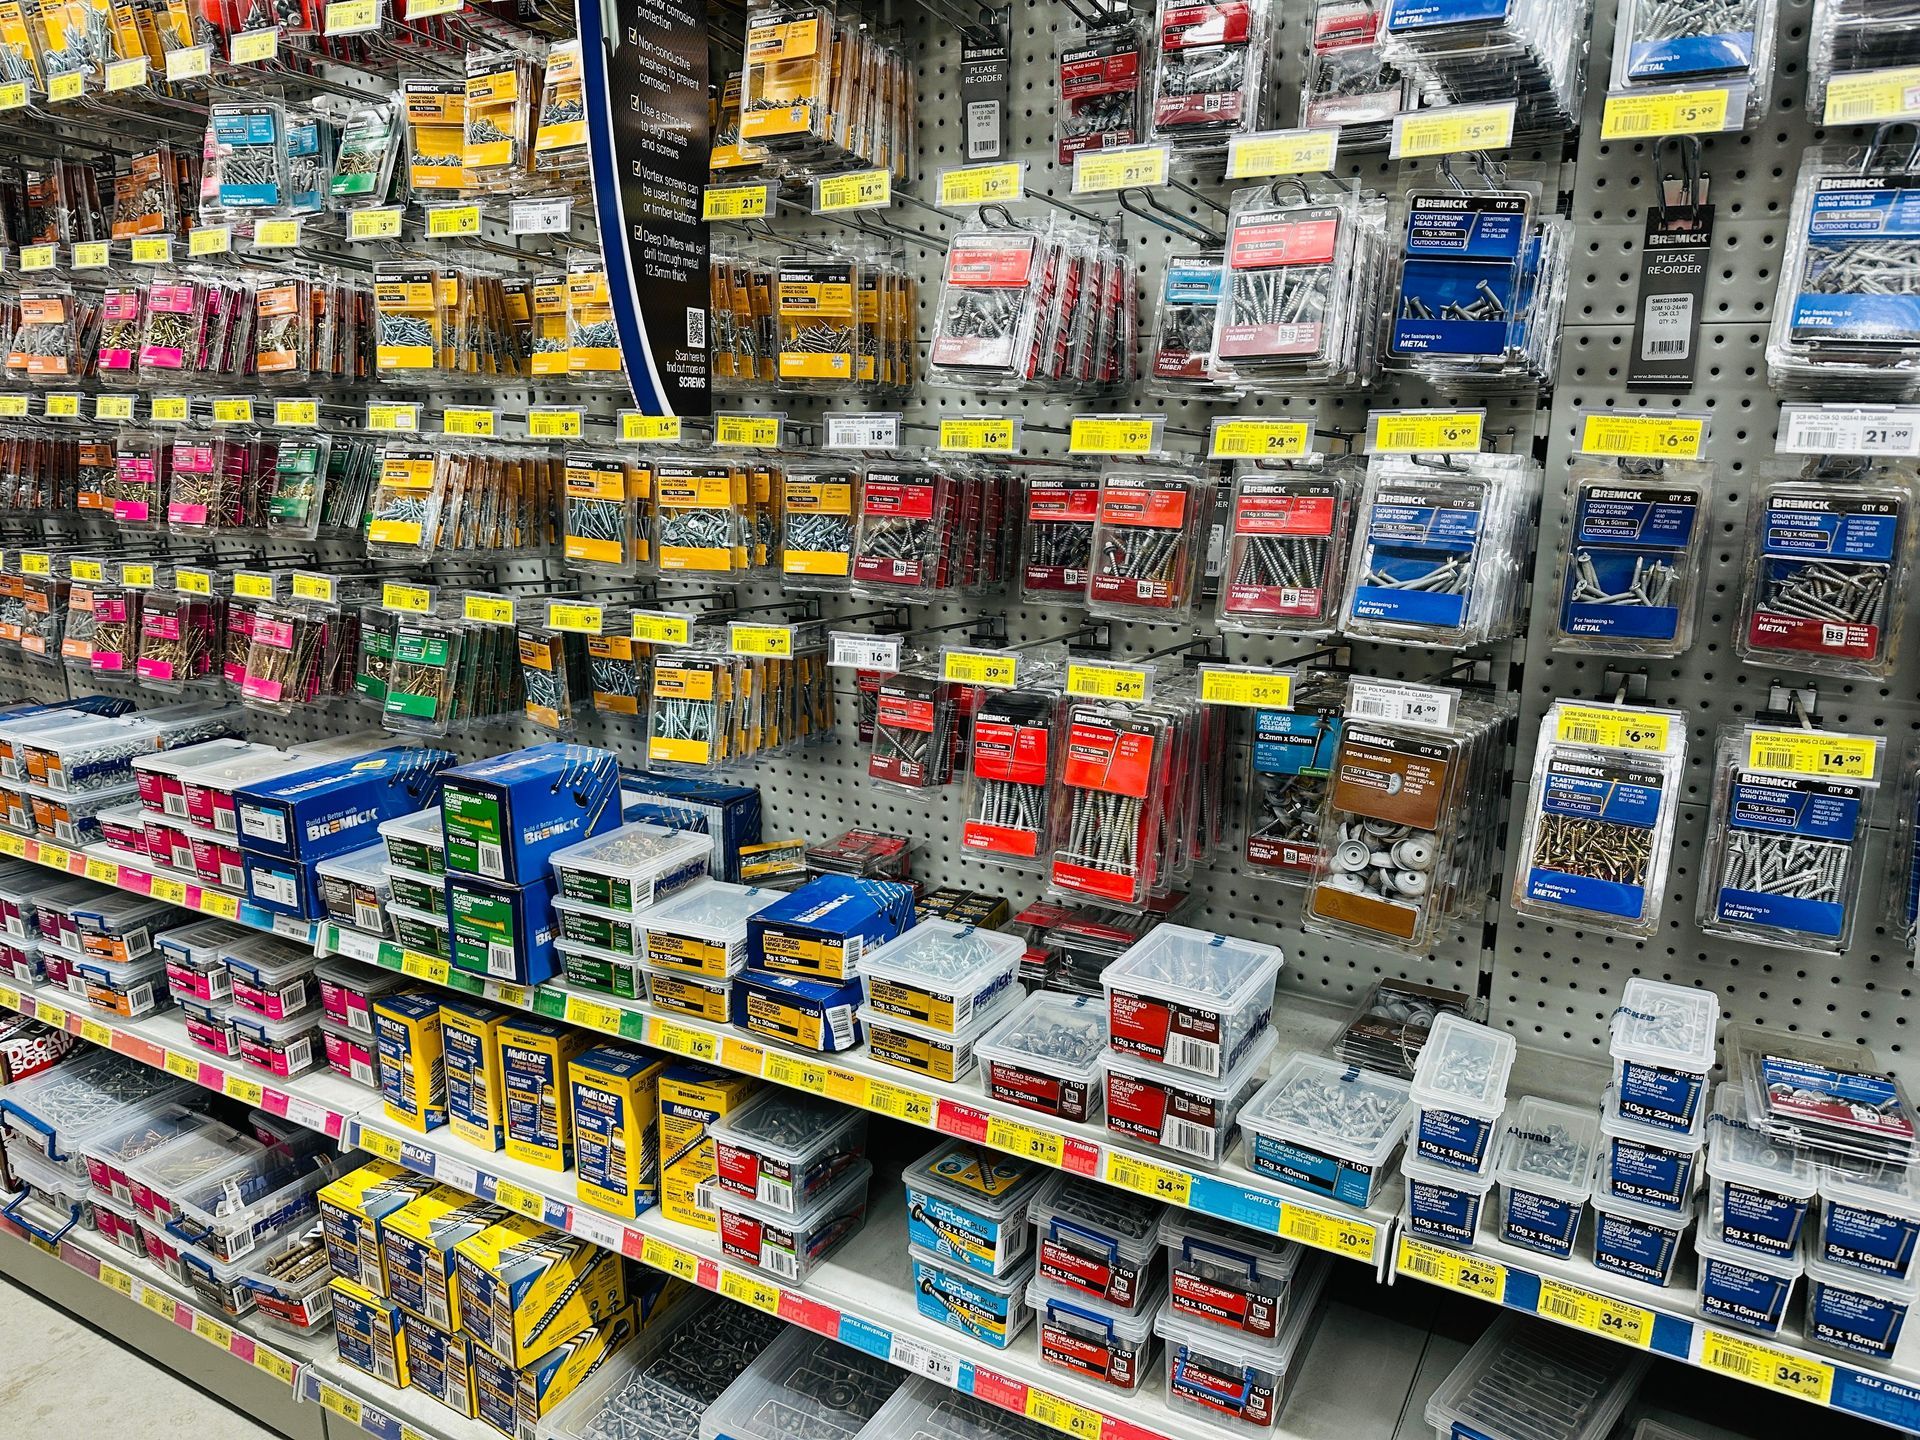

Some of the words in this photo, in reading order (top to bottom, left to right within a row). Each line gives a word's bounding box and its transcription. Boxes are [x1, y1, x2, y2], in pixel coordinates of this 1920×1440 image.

[638, 6, 672, 31] protection
[667, 5, 695, 28] corrosion
[1394, 13, 1423, 25] METAL
[639, 35, 691, 70] Non-conductive
[964, 48, 1004, 58] BREMICK
[639, 55, 667, 76] washers
[669, 67, 675, 79] to
[970, 65, 997, 74] PLEASE
[640, 73, 671, 94] corrosion
[965, 73, 1002, 84] RE-ORDER
[1159, 101, 1185, 112] TIMBER
[1680, 106, 1714, 121] $5.99
[641, 119, 648, 131] to
[642, 138, 654, 151] and
[656, 143, 679, 159] screws
[642, 166, 663, 184] Vortex
[665, 176, 686, 191] screws
[688, 186, 698, 195] can
[1820, 179, 1885, 190] BREMICK
[643, 183, 652, 195] be
[653, 188, 669, 201] used
[671, 191, 679, 204] for
[681, 197, 697, 210] metal
[1416, 198, 1468, 209] BREMICK
[644, 203, 650, 212] or
[652, 204, 672, 218] timber
[1415, 214, 1464, 222] COUNTERSUNK
[644, 230, 661, 246] Deep
[1650, 234, 1708, 244] BREMICK
[683, 258, 699, 269] metal
[1656, 254, 1695, 263] PLEASE
[672, 269, 687, 282] thick
[1647, 265, 1701, 274] RE-ORDER
[1798, 316, 1833, 325] METAL
[1400, 340, 1428, 348] METAL
[675, 350, 688, 361] Scan
[667, 361, 676, 372] find
[699, 366, 705, 374] on
[679, 376, 705, 388] SCREWS
[1444, 427, 1471, 441] $6.99
[1242, 484, 1285, 494] BREMICK
[1591, 488, 1642, 499] BREMICK
[1377, 493, 1426, 505] BREMICK
[1453, 499, 1464, 507] QTY
[1772, 498, 1830, 510] BREMICK
[1862, 504, 1876, 512] QTY
[1879, 504, 1888, 512] 50
[1772, 514, 1822, 522] COUNTERSUNK
[858, 562, 878, 570] TIMBER
[1095, 582, 1119, 590] TIMBER
[1231, 591, 1260, 600] TIMBER
[1357, 606, 1384, 616] METAL
[1573, 624, 1600, 632] METAL
[1758, 624, 1788, 634] METAL
[1826, 630, 1844, 640] B8
[1406, 703, 1436, 716] 14.99
[1348, 731, 1394, 748] BREMICK
[1420, 746, 1432, 754] QTY
[1626, 729, 1655, 743] $6.99
[1823, 753, 1861, 767] 14.99
[1552, 762, 1604, 777] BREMICK
[1644, 775, 1656, 783] 100
[1551, 776, 1603, 788] PLASTERBOARD
[1742, 774, 1798, 788] BREMICK
[1828, 786, 1842, 794] QTY
[445, 792, 482, 805] PLASTERBOARD
[484, 793, 498, 801] 1000
[1740, 788, 1790, 798] COUNTERSUNK
[1759, 795, 1786, 803] DRILLER
[306, 819, 321, 827] Build
[327, 812, 344, 823] Better
[345, 807, 357, 816] with
[307, 807, 379, 842] BREMICK
[524, 817, 580, 845] BREMICK
[453, 893, 494, 907] PLASTERBOARD
[496, 895, 510, 904] 1000
[1533, 888, 1562, 899] METAL
[1724, 909, 1755, 919] METAL
[828, 939, 841, 947] 250
[873, 1000, 885, 1009] 10g
[891, 1004, 911, 1016] 30mm
[1200, 1010, 1217, 1021] 100
[507, 1048, 527, 1061] Multi
[528, 1054, 547, 1065] ONE
[1629, 1066, 1657, 1078] WAFER
[1659, 1074, 1678, 1083] HEAD
[578, 1086, 598, 1099] Multi
[598, 1092, 618, 1106] ONE
[906, 1101, 929, 1114] 24.95
[954, 1107, 968, 1115] TYPE
[1624, 1102, 1643, 1115] 10g
[1653, 1109, 1689, 1126] 22mm
[1420, 1141, 1438, 1154] 10g
[1448, 1148, 1478, 1165] 16mm
[1258, 1158, 1277, 1173] 12g
[1285, 1167, 1311, 1182] 40mm
[1350, 1162, 1369, 1174] 100
[1157, 1178, 1186, 1193] 34.99
[1615, 1181, 1636, 1194] 10g
[1645, 1188, 1680, 1203] 22mm
[1243, 1193, 1274, 1206] VORTEX
[1729, 1190, 1762, 1204] BUTTON
[1764, 1199, 1788, 1209] HEAD
[336, 1209, 349, 1220] ONE
[930, 1204, 971, 1227] vortex
[400, 1235, 415, 1250] ONE
[1338, 1231, 1371, 1246] 20.95
[1725, 1227, 1741, 1238] 8g
[1752, 1233, 1789, 1249] 16mm
[1828, 1244, 1844, 1256] 8g
[1856, 1252, 1896, 1269] 16mm
[1460, 1269, 1494, 1286] 24.99
[1256, 1294, 1273, 1305] 100
[840, 1315, 861, 1328] VORTEX
[861, 1321, 890, 1339] UNIVERSAL
[1602, 1312, 1638, 1330] 34.99
[1778, 1367, 1819, 1385] 34.99
[1855, 1376, 1882, 1388] SELF
